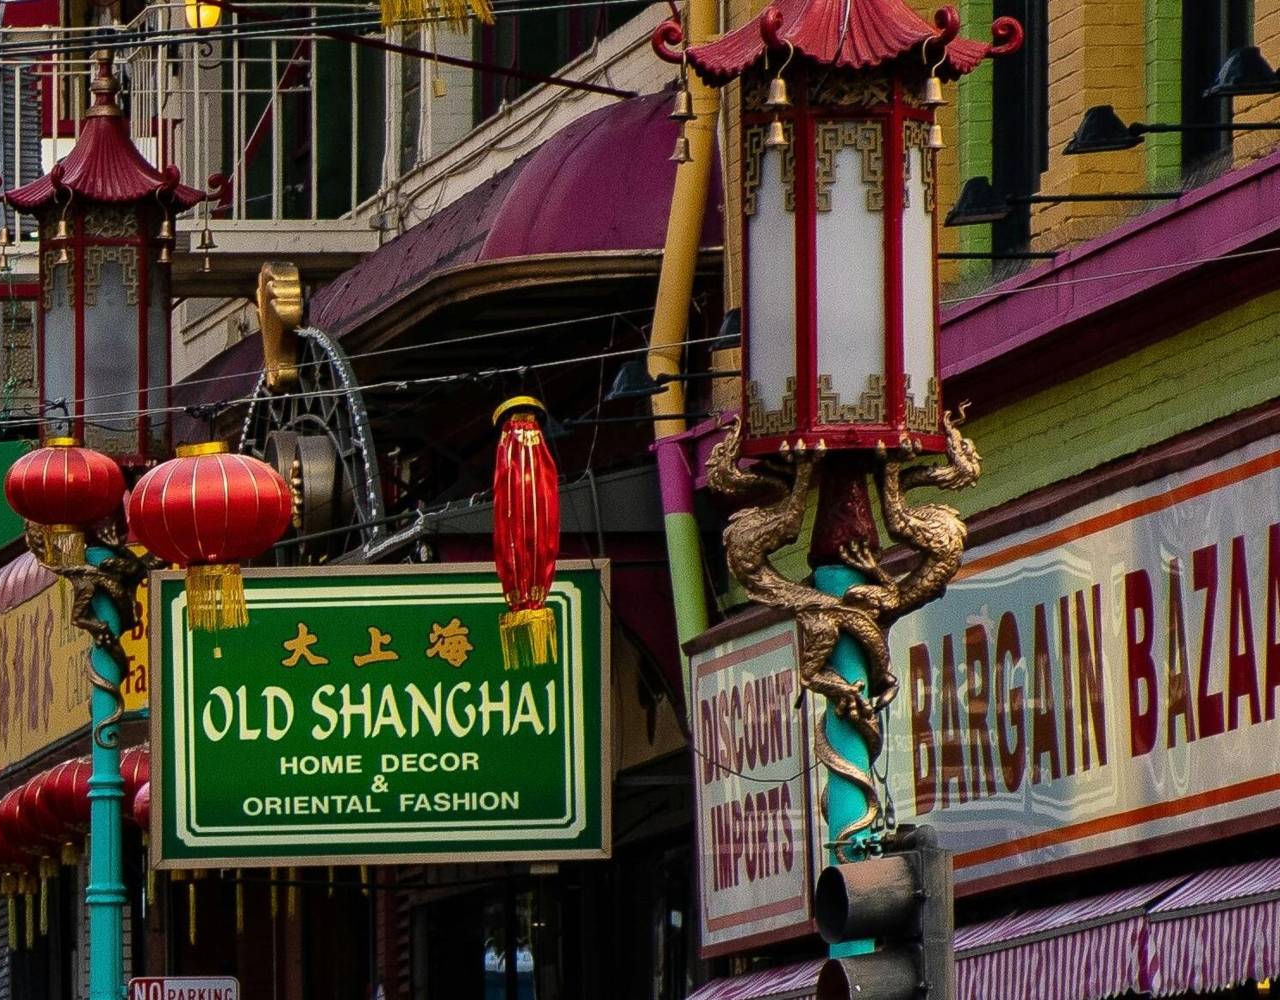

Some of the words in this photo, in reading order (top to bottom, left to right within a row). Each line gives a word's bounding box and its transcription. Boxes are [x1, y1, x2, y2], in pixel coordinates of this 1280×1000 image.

[281, 618, 474, 667] 大上海
[202, 685, 294, 741] OLD
[311, 680, 555, 740] SHANGHAI
[909, 584, 1107, 816] BARGAIN
[701, 668, 793, 785] DISCOUNT
[280, 756, 362, 775] HOME
[381, 753, 479, 772] DECOR
[370, 774, 389, 793] &
[243, 794, 381, 816] ORIENTAL
[399, 790, 520, 813] FASHION
[711, 782, 794, 892] IMPORTS
[134, 982, 162, 1000] NO
